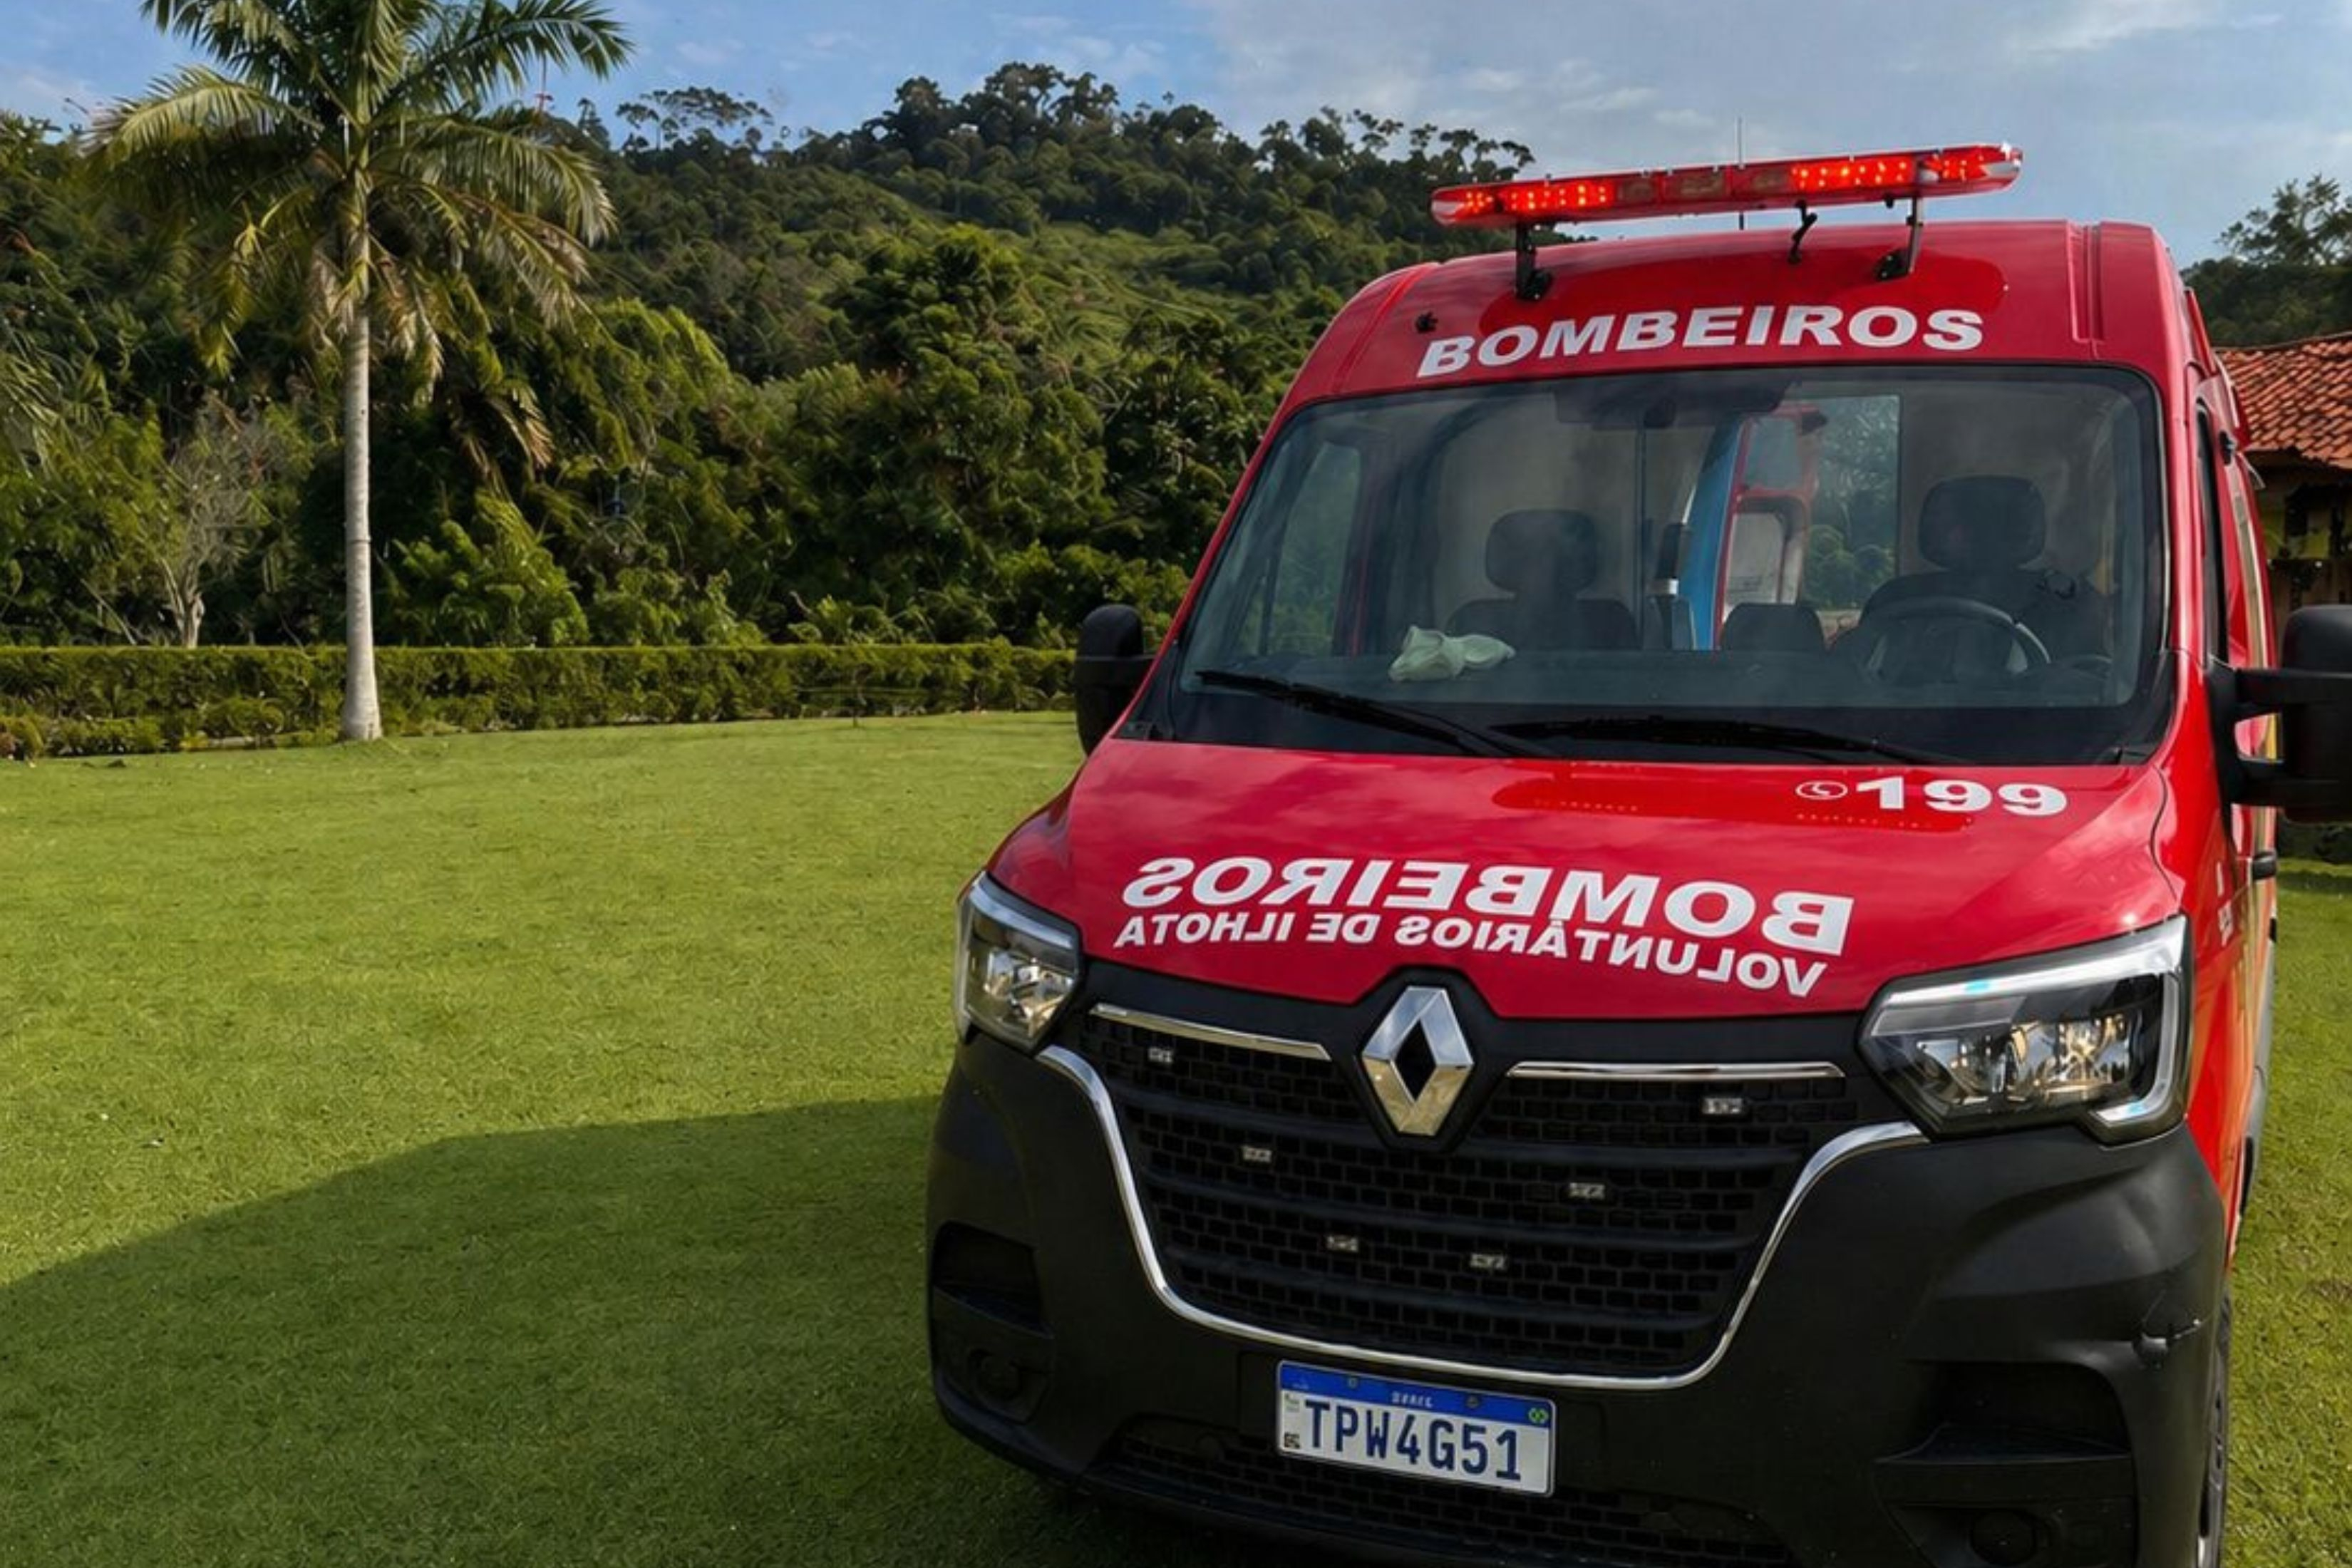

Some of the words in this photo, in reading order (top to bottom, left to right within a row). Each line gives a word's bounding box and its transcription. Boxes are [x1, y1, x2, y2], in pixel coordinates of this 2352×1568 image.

[1417, 304, 1984, 378] BOMBEIROS
[1856, 776, 2068, 817] 199
[1304, 1398, 1522, 1482] TPW4G51
